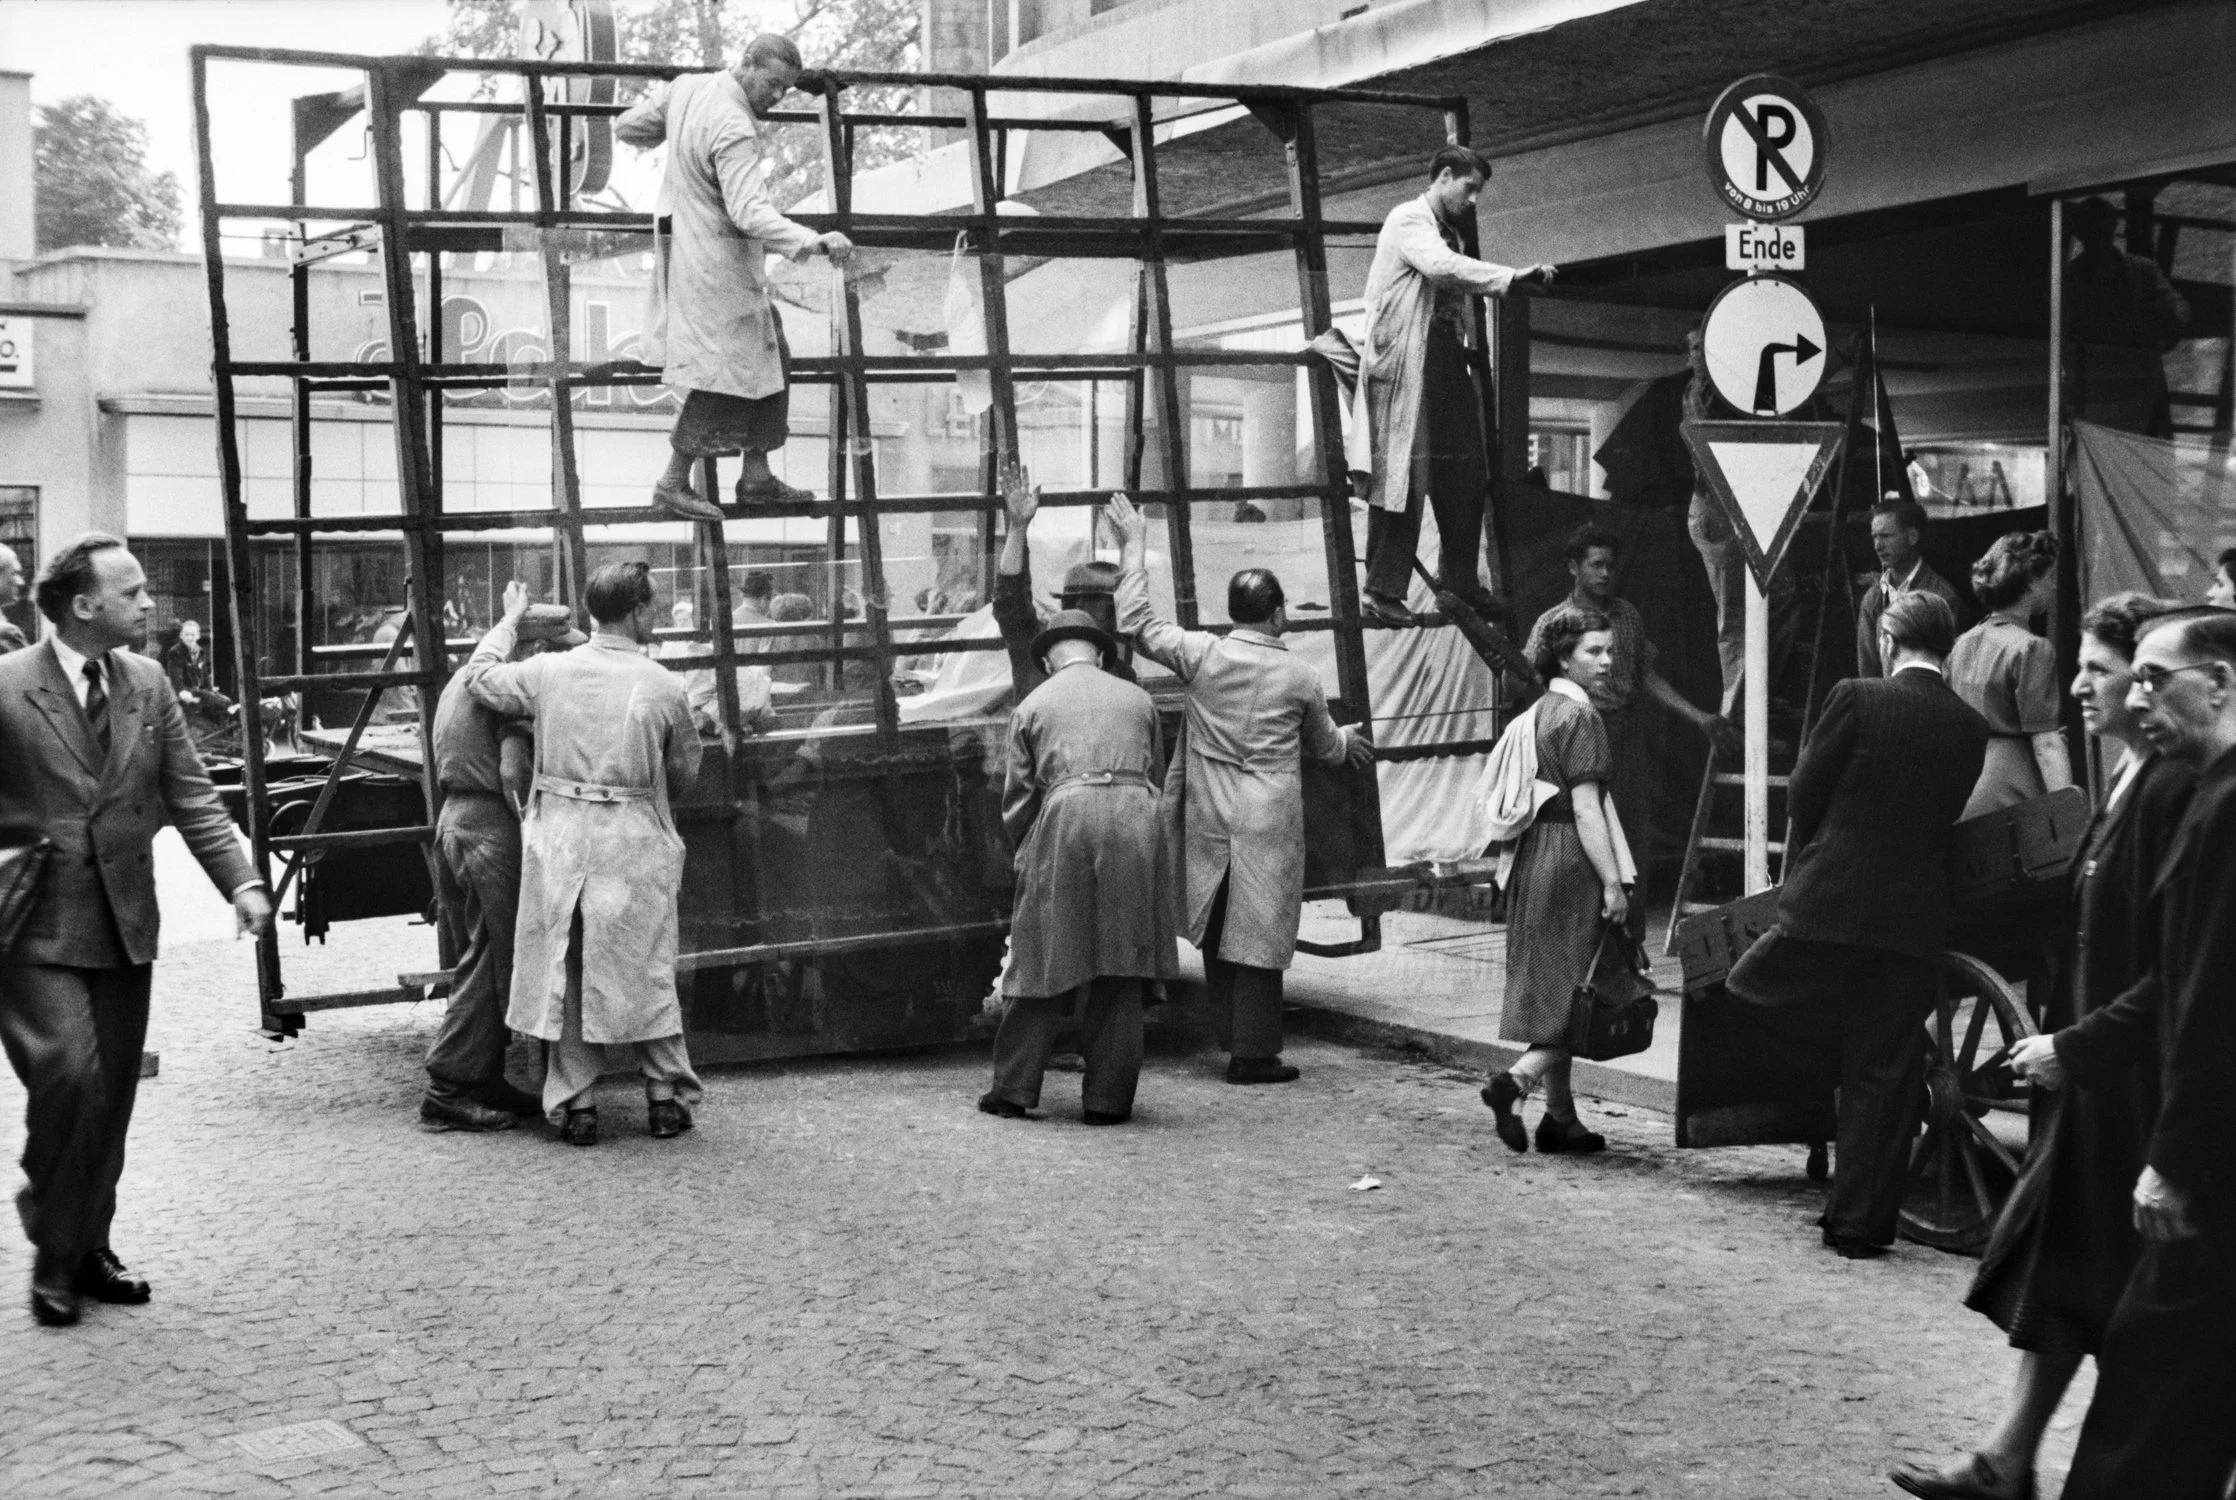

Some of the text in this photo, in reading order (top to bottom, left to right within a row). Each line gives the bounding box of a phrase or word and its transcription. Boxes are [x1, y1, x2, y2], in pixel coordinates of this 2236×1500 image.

[1756, 104, 1796, 191] P
[1725, 182, 1810, 214] von 8 bis 19 Uhr
[1739, 226, 1796, 260] Ende
